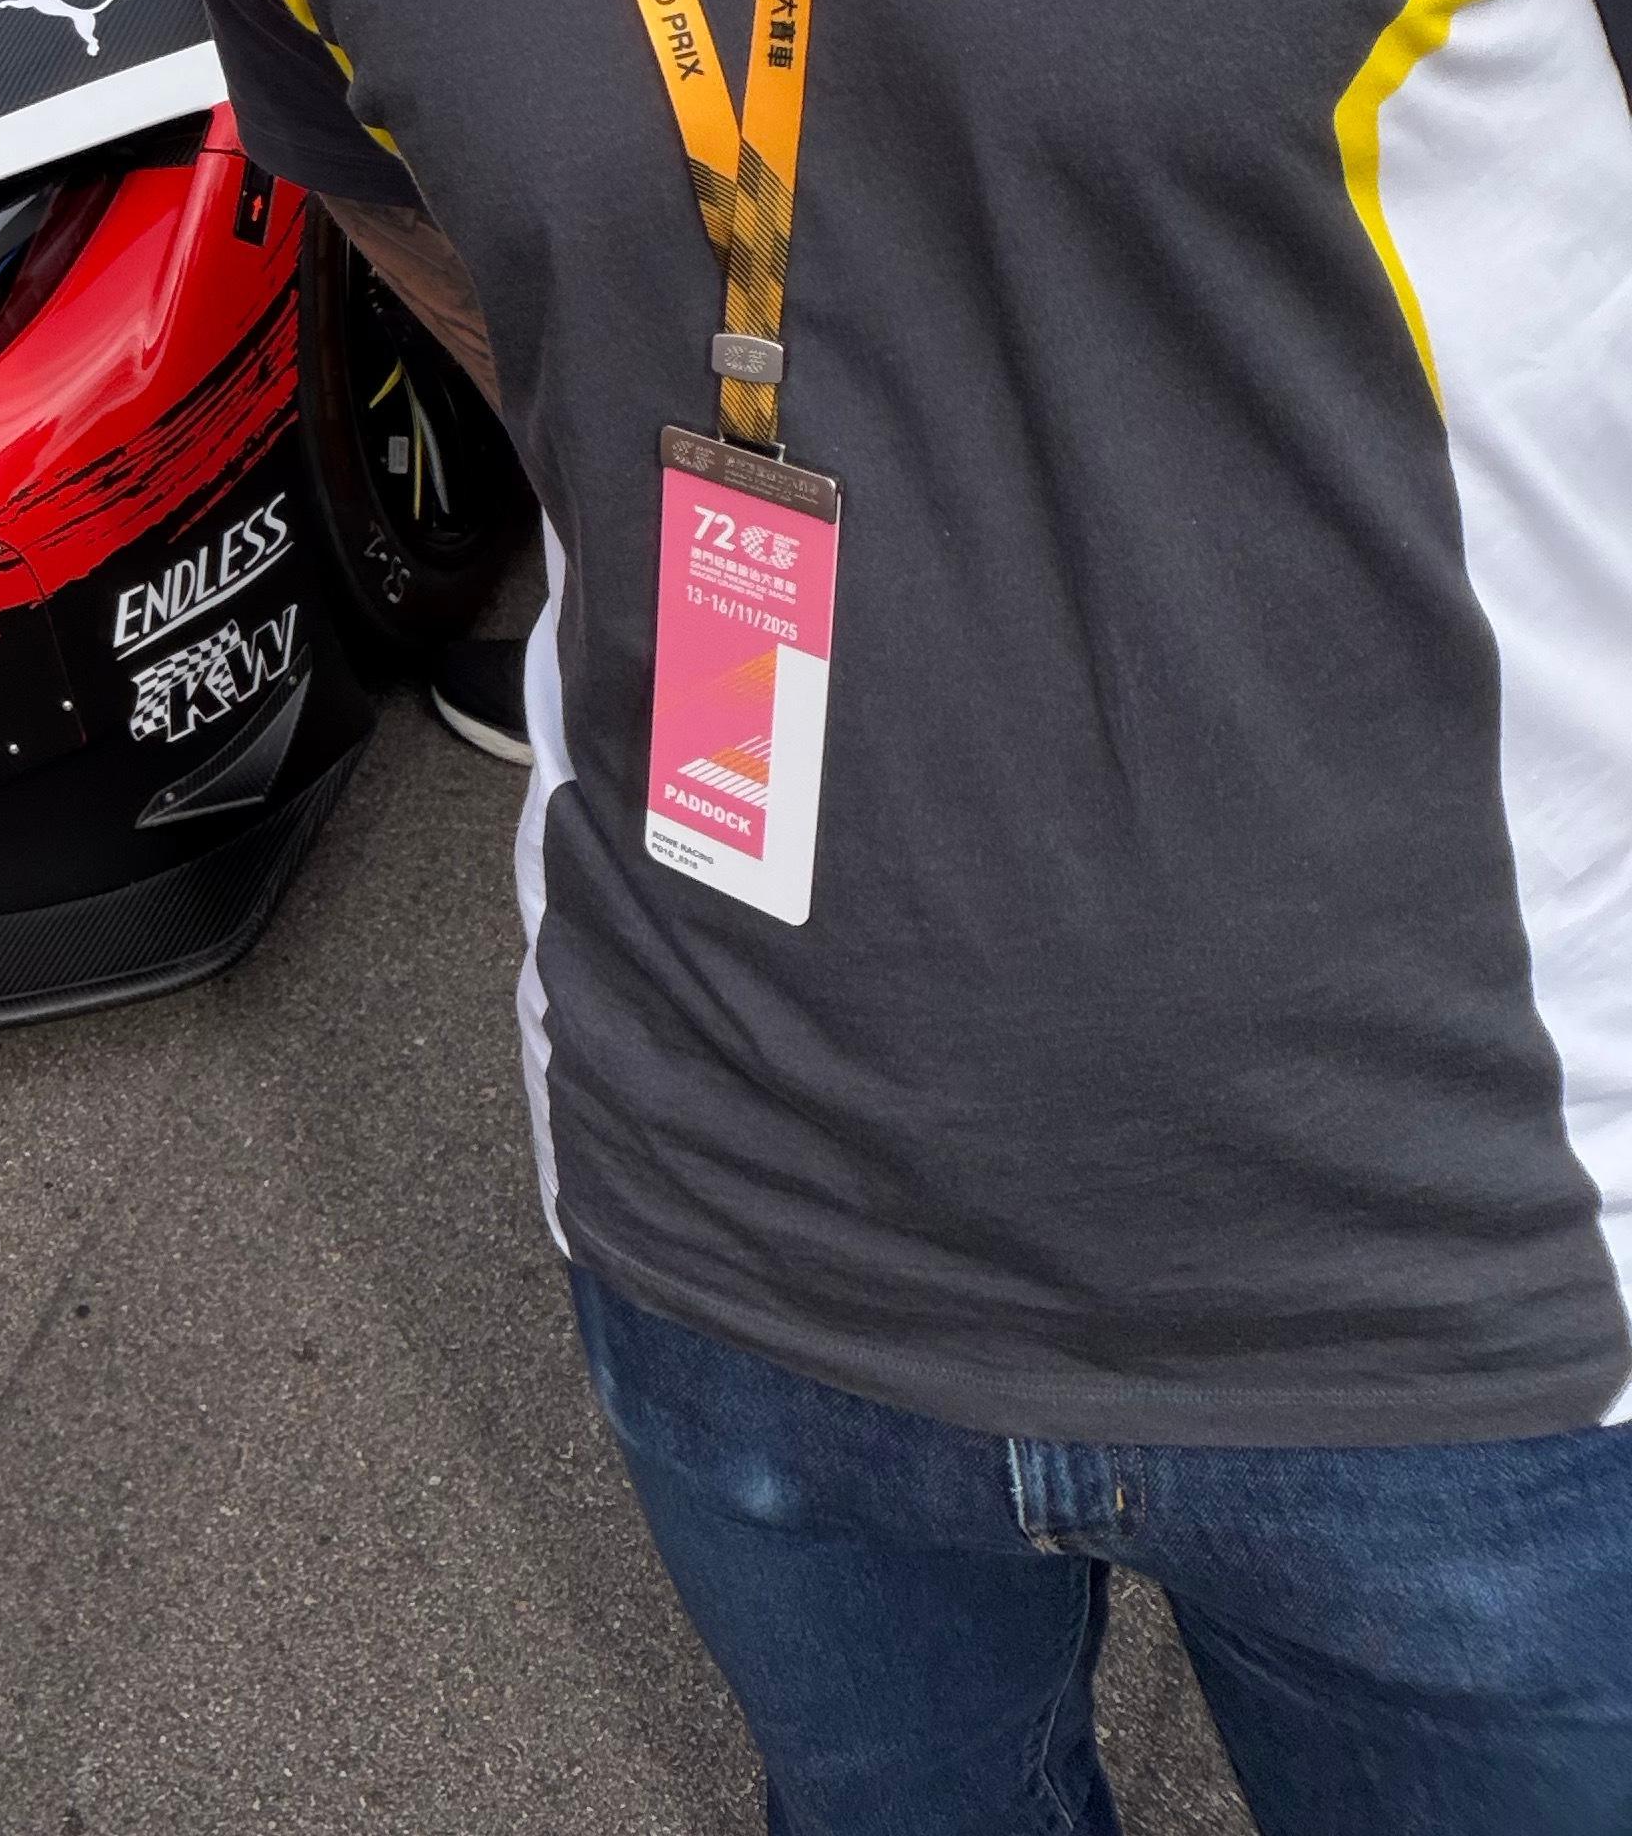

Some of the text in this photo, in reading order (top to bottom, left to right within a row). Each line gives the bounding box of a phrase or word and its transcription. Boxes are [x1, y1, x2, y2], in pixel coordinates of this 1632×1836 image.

[662, 12, 705, 82] PRIX
[694, 505, 737, 551] 72
[113, 492, 288, 648] ENDLESS
[687, 584, 798, 641] 13-16/11/2025
[166, 604, 298, 743] KW
[663, 783, 752, 837] PADDOCK
